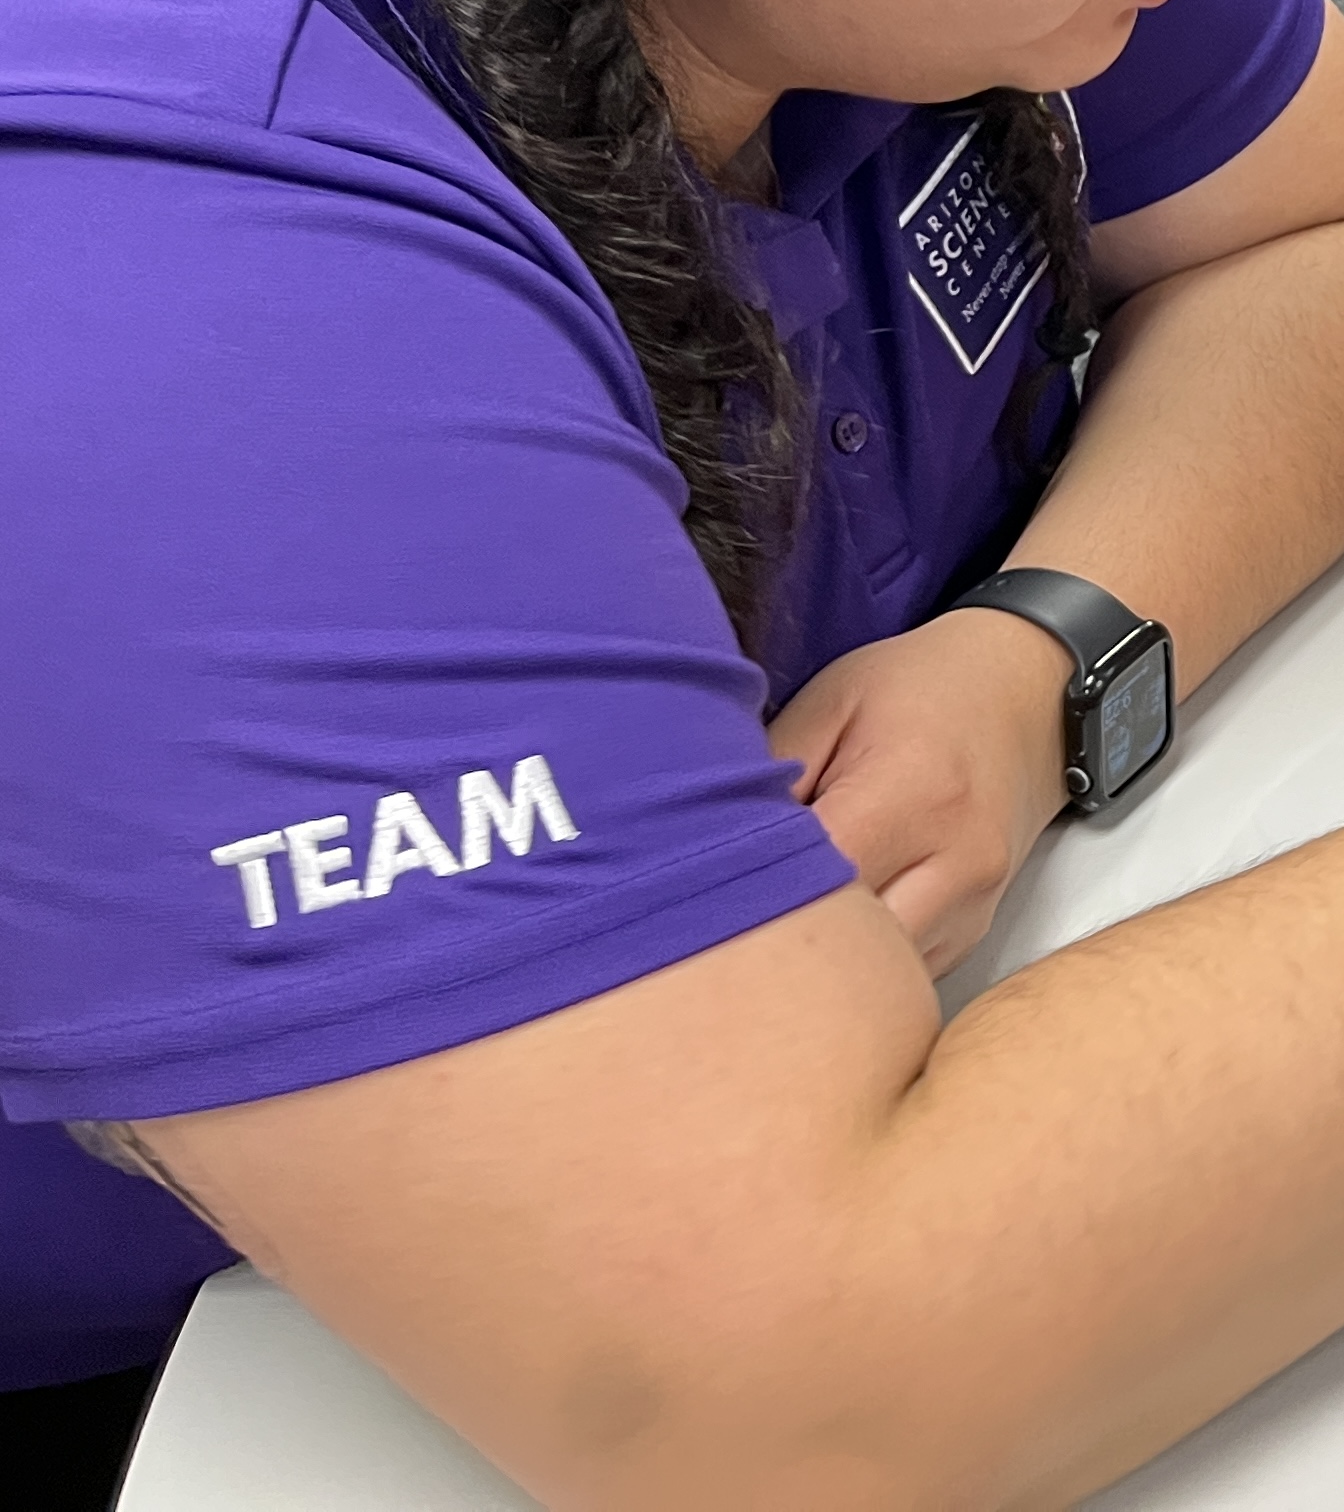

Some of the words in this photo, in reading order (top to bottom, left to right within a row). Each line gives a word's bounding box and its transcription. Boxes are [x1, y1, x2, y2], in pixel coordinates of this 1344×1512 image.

[914, 154, 986, 250] ARIZON
[928, 171, 999, 278] SCIENC
[946, 202, 1011, 295] CENTE
[210, 754, 581, 929] TEAM
